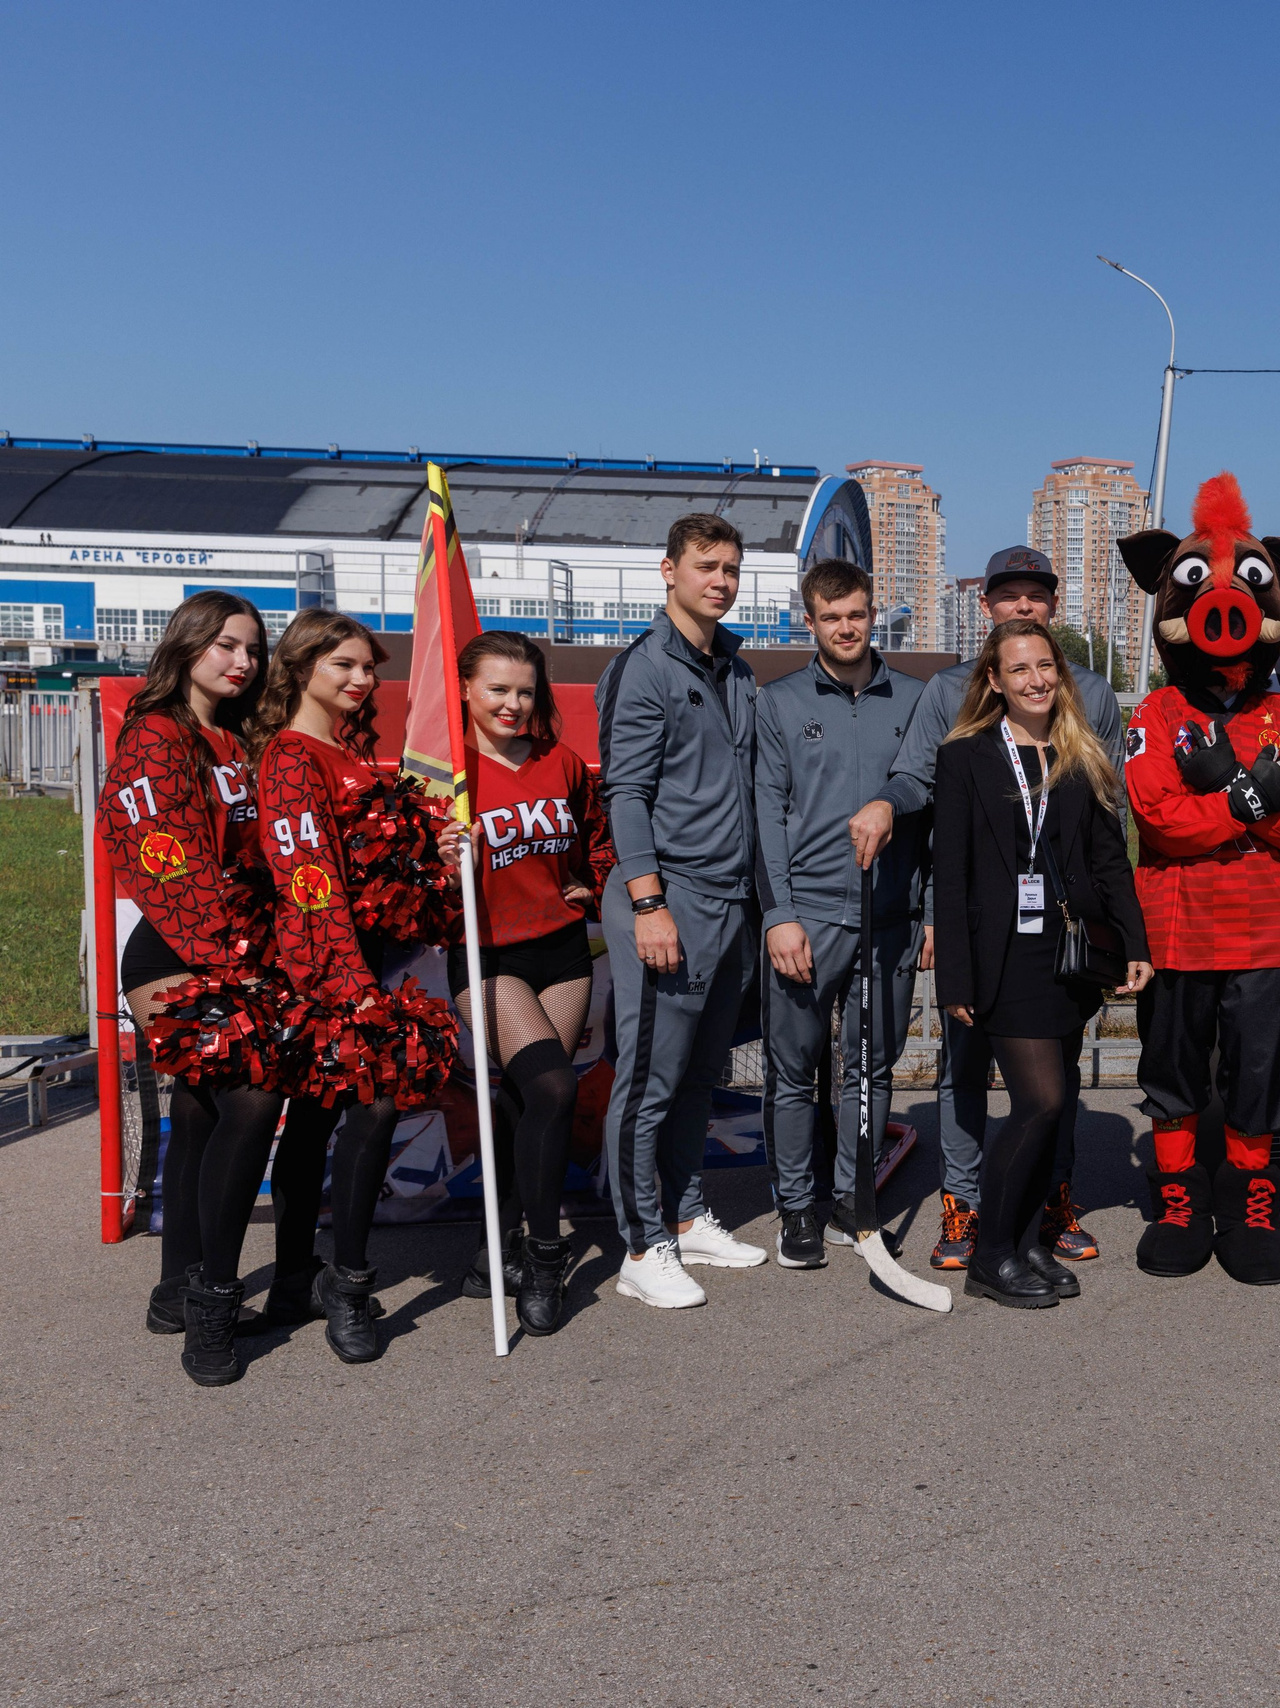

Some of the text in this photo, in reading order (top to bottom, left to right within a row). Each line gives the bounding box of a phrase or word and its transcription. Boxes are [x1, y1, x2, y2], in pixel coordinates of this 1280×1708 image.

[69, 550, 213, 566] АРЕНА "ЕРОФЕЙ"
[118, 776, 158, 825] 87
[1241, 786, 1267, 820] STEX
[273, 811, 320, 856] 94
[479, 798, 579, 849] СКА
[146, 846, 182, 867] СКА
[296, 875, 325, 900] СКА
[860, 1076, 869, 1139] STEX
